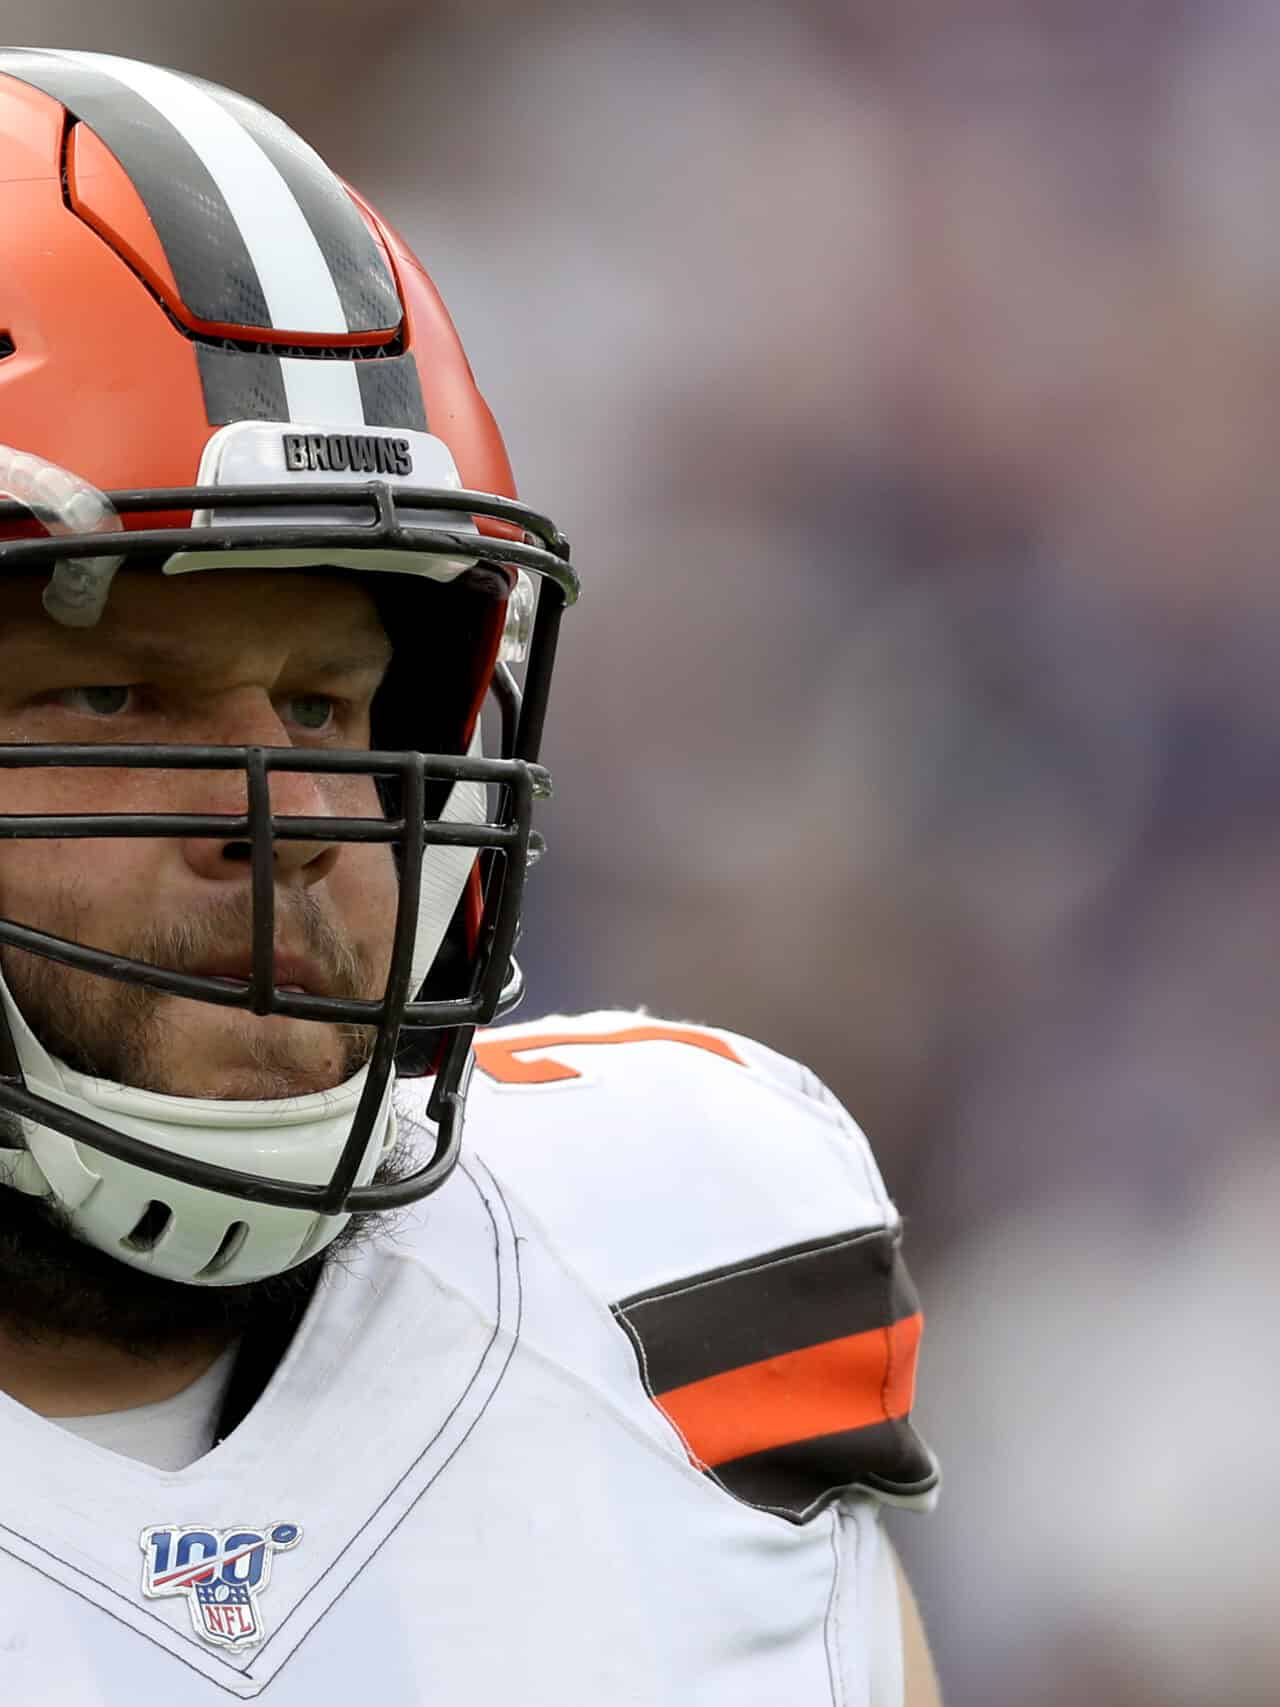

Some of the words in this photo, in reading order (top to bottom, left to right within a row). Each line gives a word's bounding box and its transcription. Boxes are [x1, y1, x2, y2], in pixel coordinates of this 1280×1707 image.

[283, 434, 413, 476] BROWNS
[151, 1531, 267, 1587] 100
[204, 1605, 252, 1637] NFL
